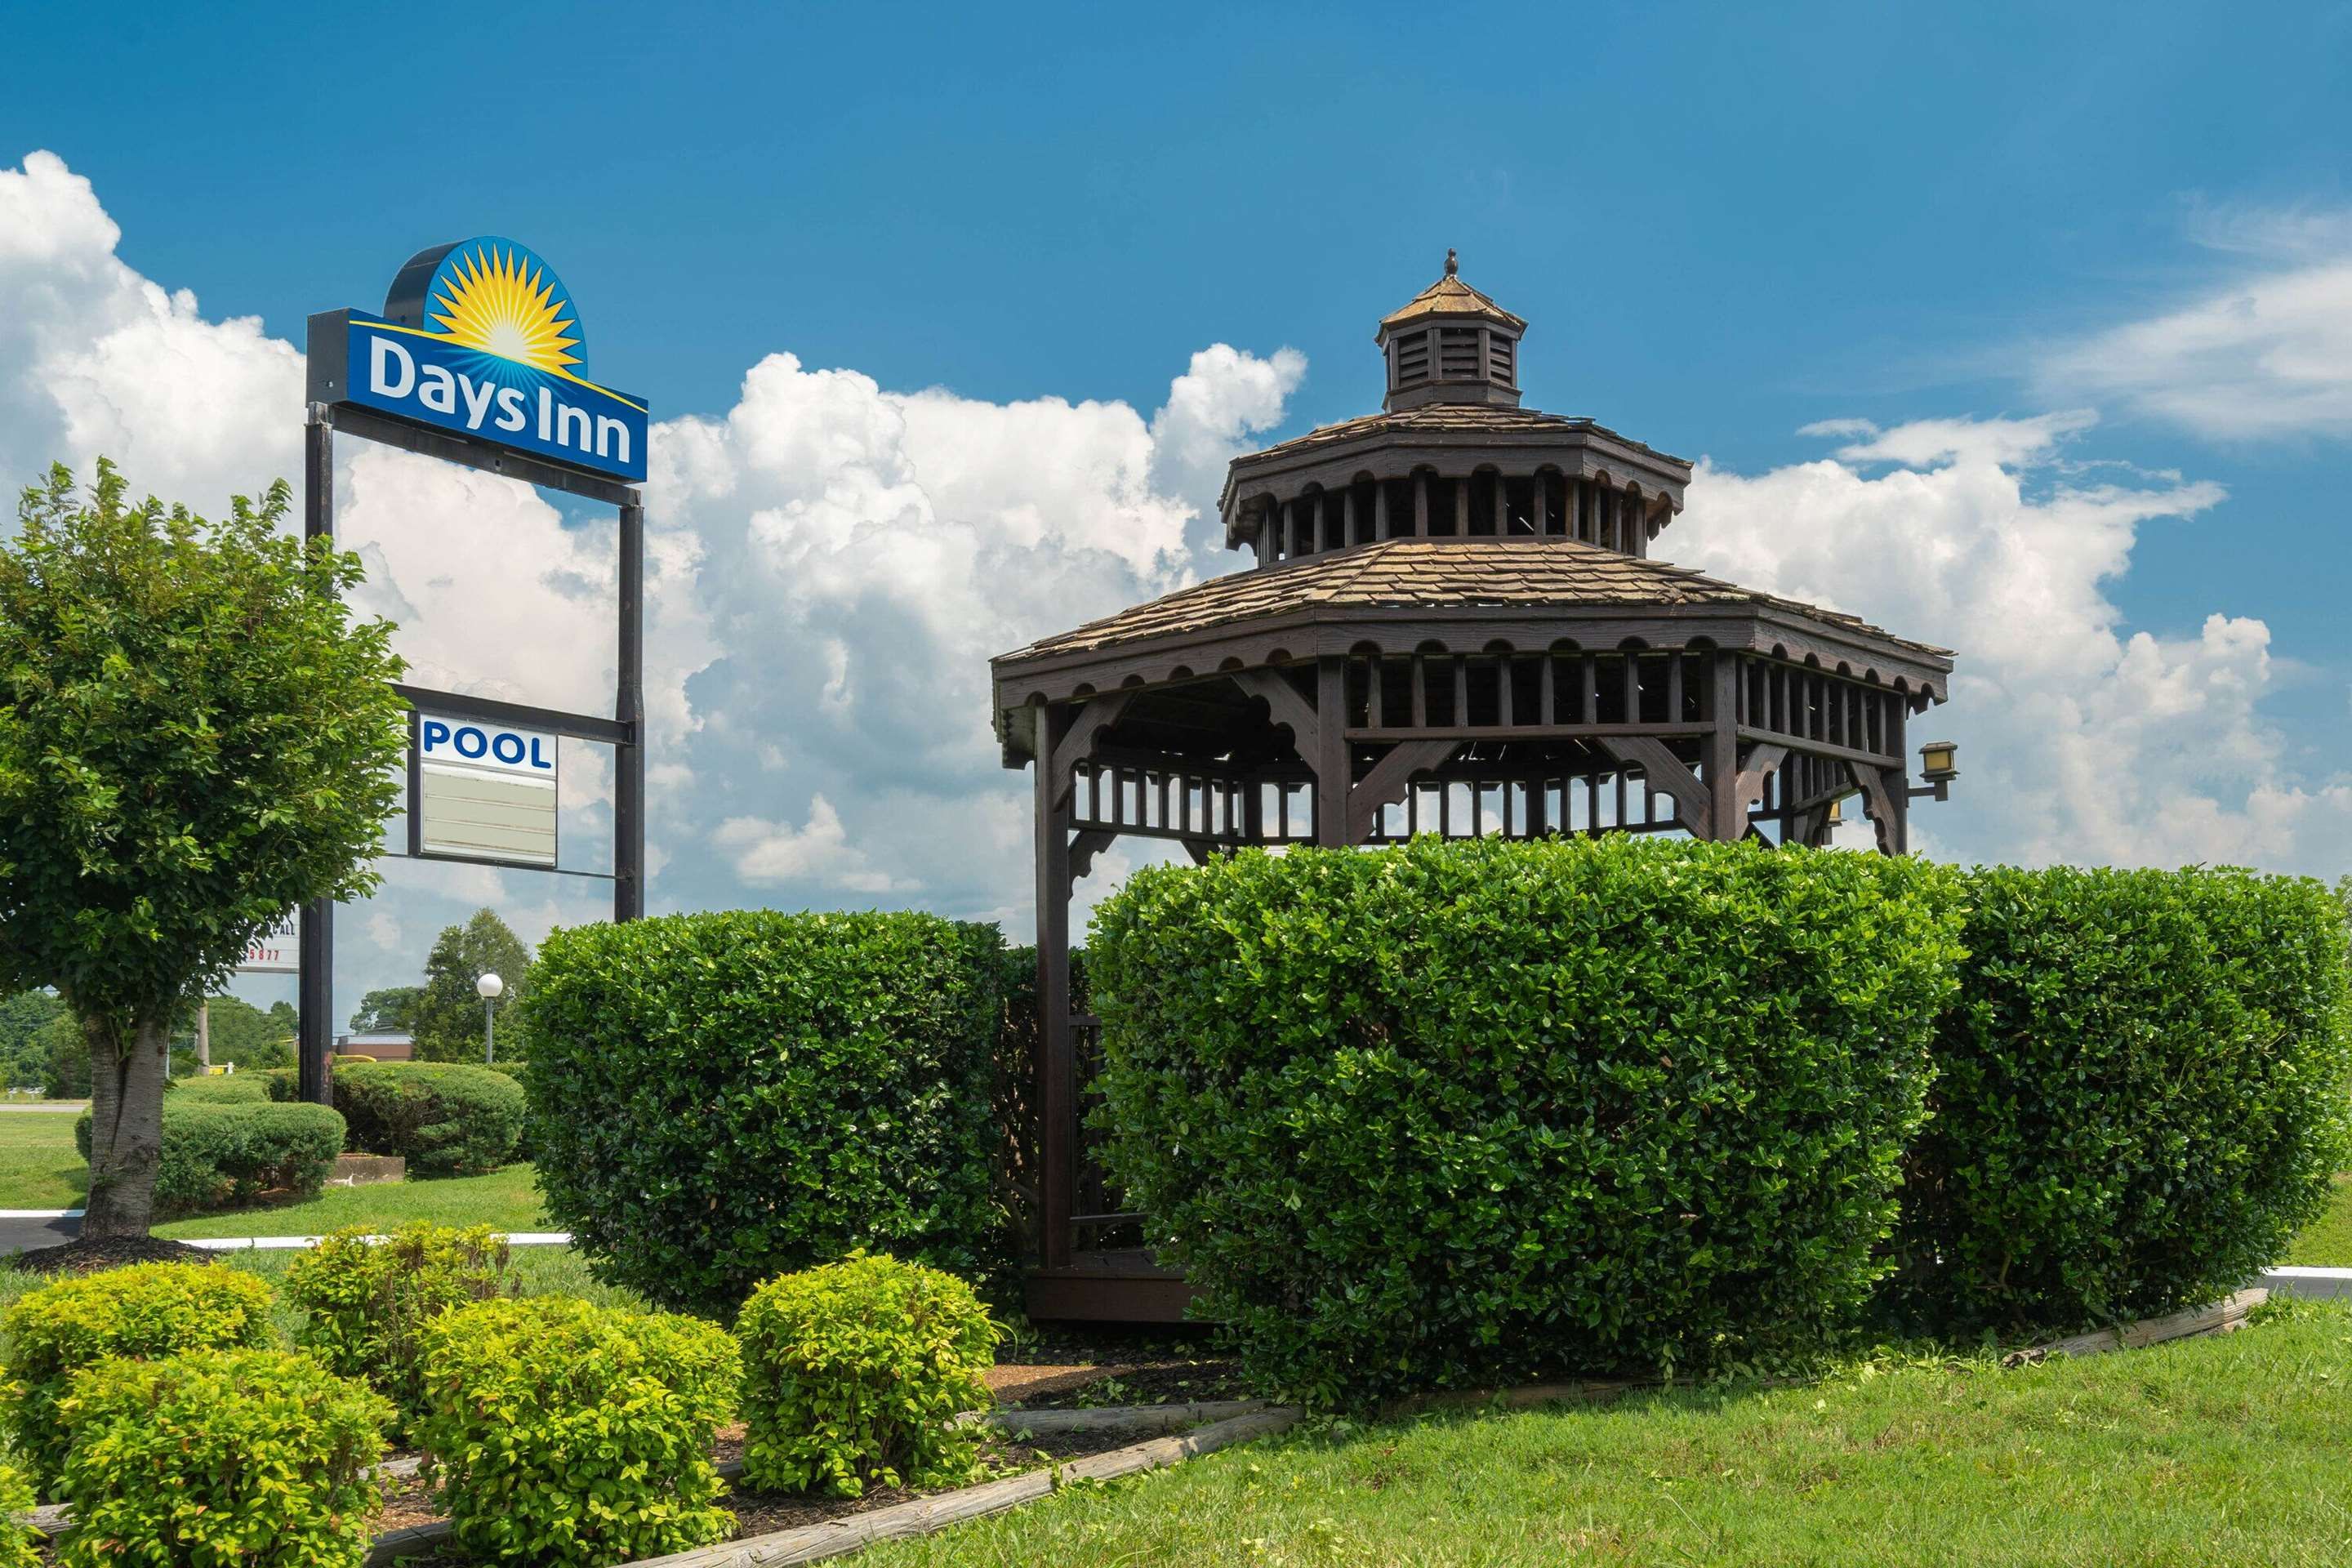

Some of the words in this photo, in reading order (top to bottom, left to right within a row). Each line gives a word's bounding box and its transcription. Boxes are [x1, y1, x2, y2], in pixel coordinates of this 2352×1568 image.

[370, 335, 527, 431] Days
[538, 386, 630, 463] Inn
[424, 721, 551, 768] POOL
